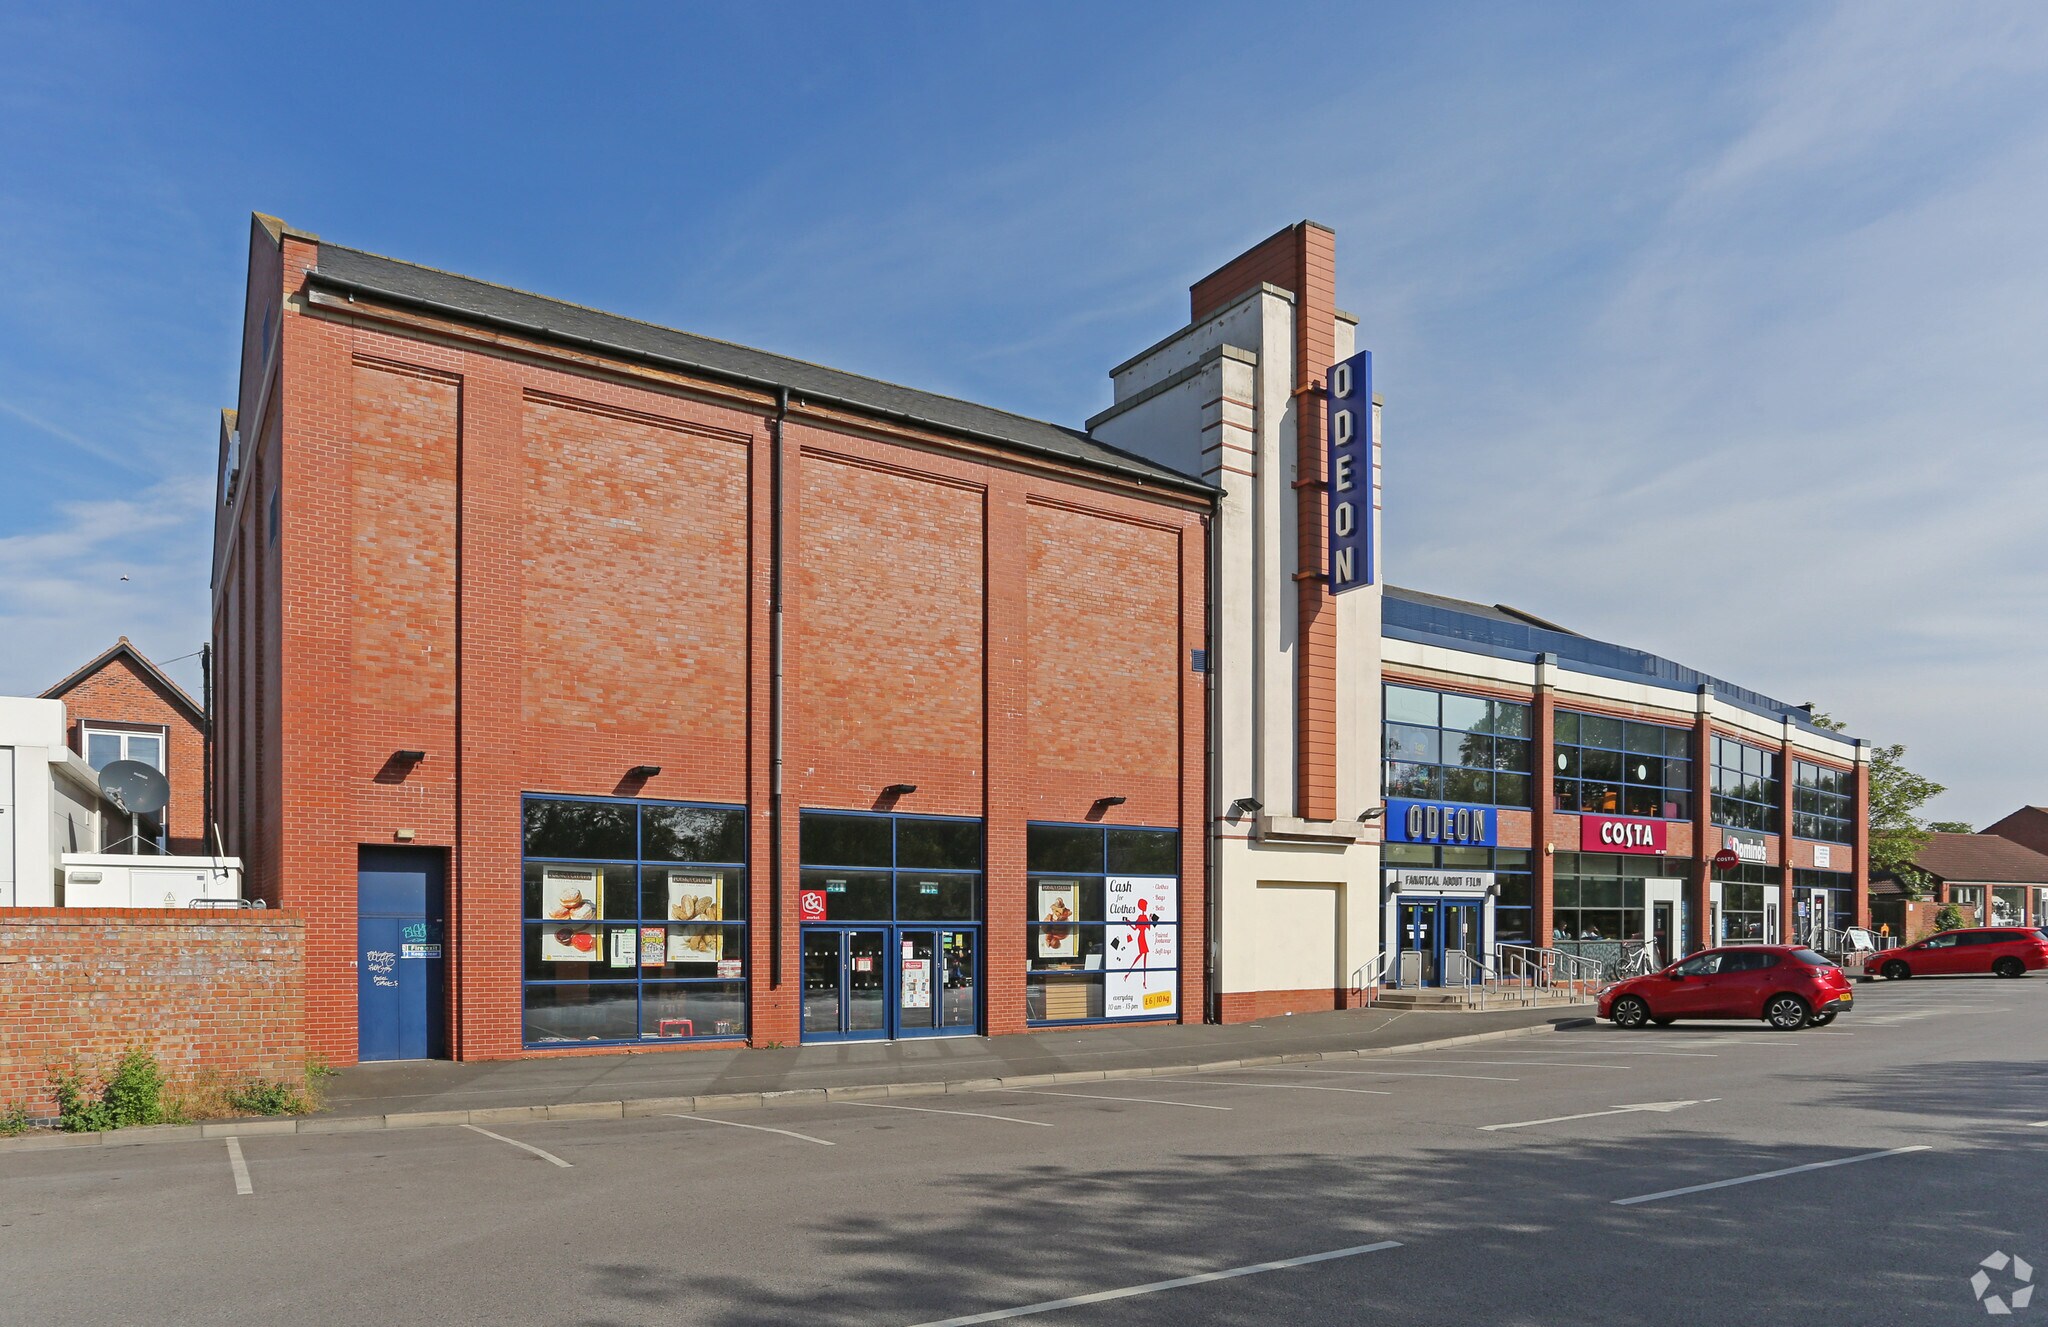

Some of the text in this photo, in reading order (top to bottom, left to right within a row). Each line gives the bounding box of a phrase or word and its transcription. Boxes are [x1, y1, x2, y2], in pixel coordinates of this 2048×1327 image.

[1333, 362, 1354, 585] ODEON
[1408, 804, 1485, 842] ODEON
[1601, 821, 1654, 848] COSTA
[1732, 836, 1767, 861] Domino's
[1109, 879, 1132, 893] Cash
[1405, 875, 1482, 887] FANATICAL ABOUT FILM
[1116, 894, 1124, 902] for
[1109, 903, 1136, 914] Clothes
[1112, 994, 1134, 1003] everyday
